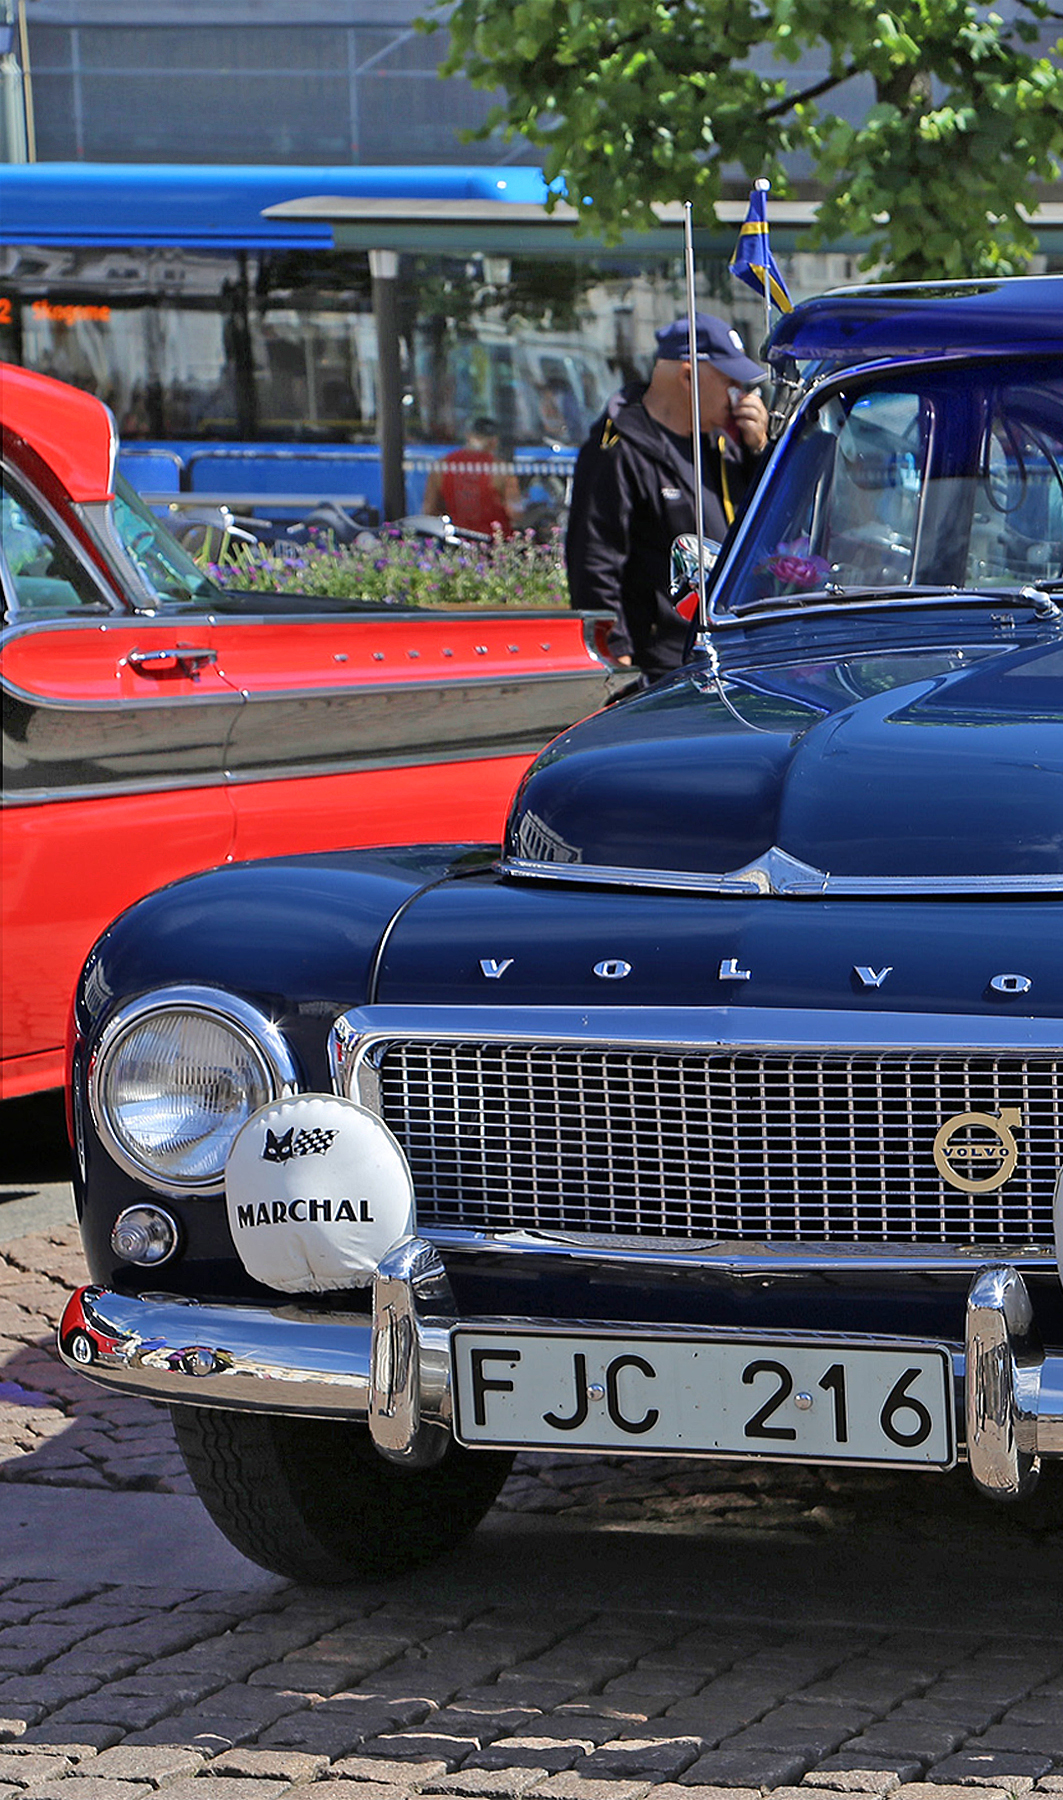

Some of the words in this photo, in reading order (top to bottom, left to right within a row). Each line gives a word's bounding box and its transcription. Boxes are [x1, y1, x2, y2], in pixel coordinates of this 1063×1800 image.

[479, 957, 1032, 994] VOLVO
[942, 1148, 1009, 1157] VOLVO
[237, 1199, 374, 1229] MARCHAL
[470, 1348, 659, 1434] FJC
[742, 1359, 932, 1447] 216
